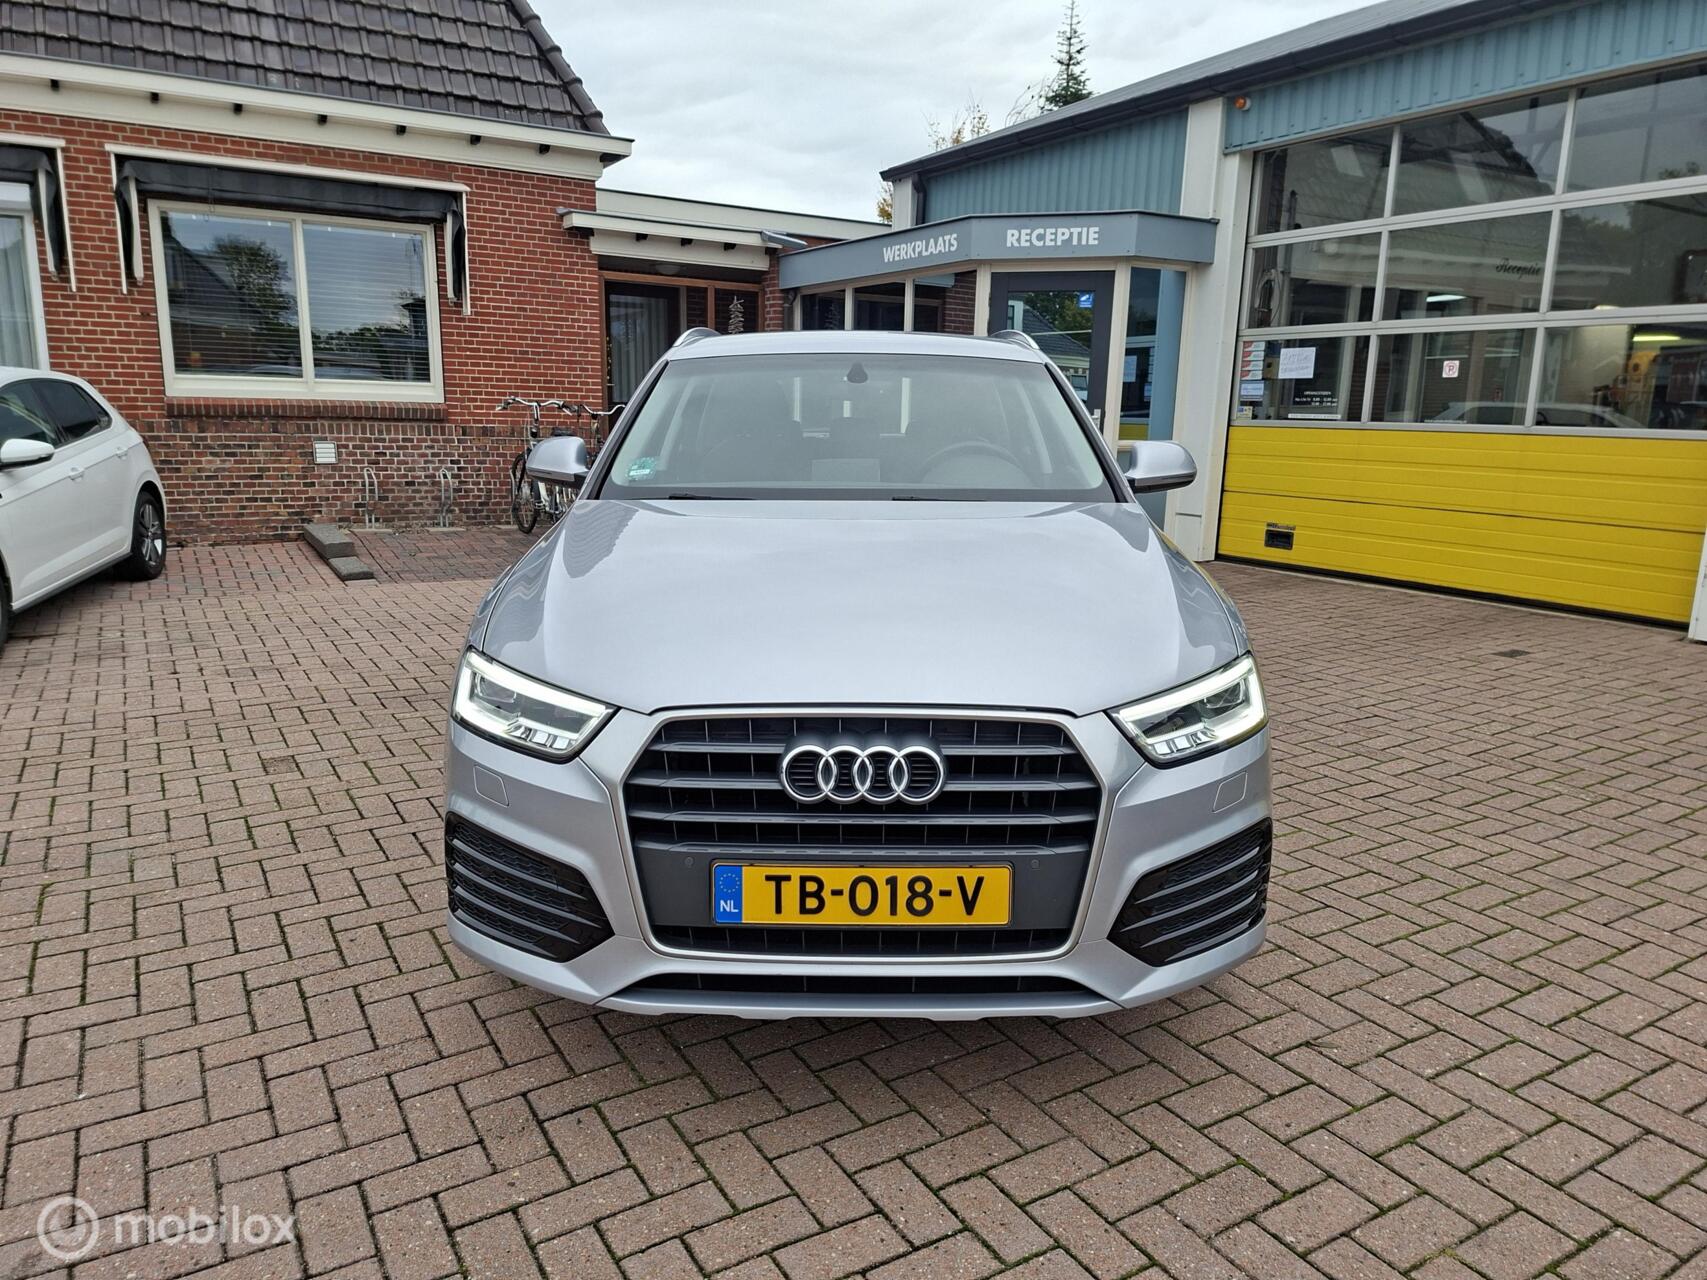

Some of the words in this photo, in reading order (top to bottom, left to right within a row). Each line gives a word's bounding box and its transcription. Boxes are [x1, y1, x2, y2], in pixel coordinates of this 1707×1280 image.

[883, 233, 958, 263] WERKPLAATS
[1006, 227, 1100, 247] RECEPTIE
[1496, 257, 1541, 279] Receptie
[720, 899, 739, 913] NL
[764, 874, 985, 917] TB-018-V
